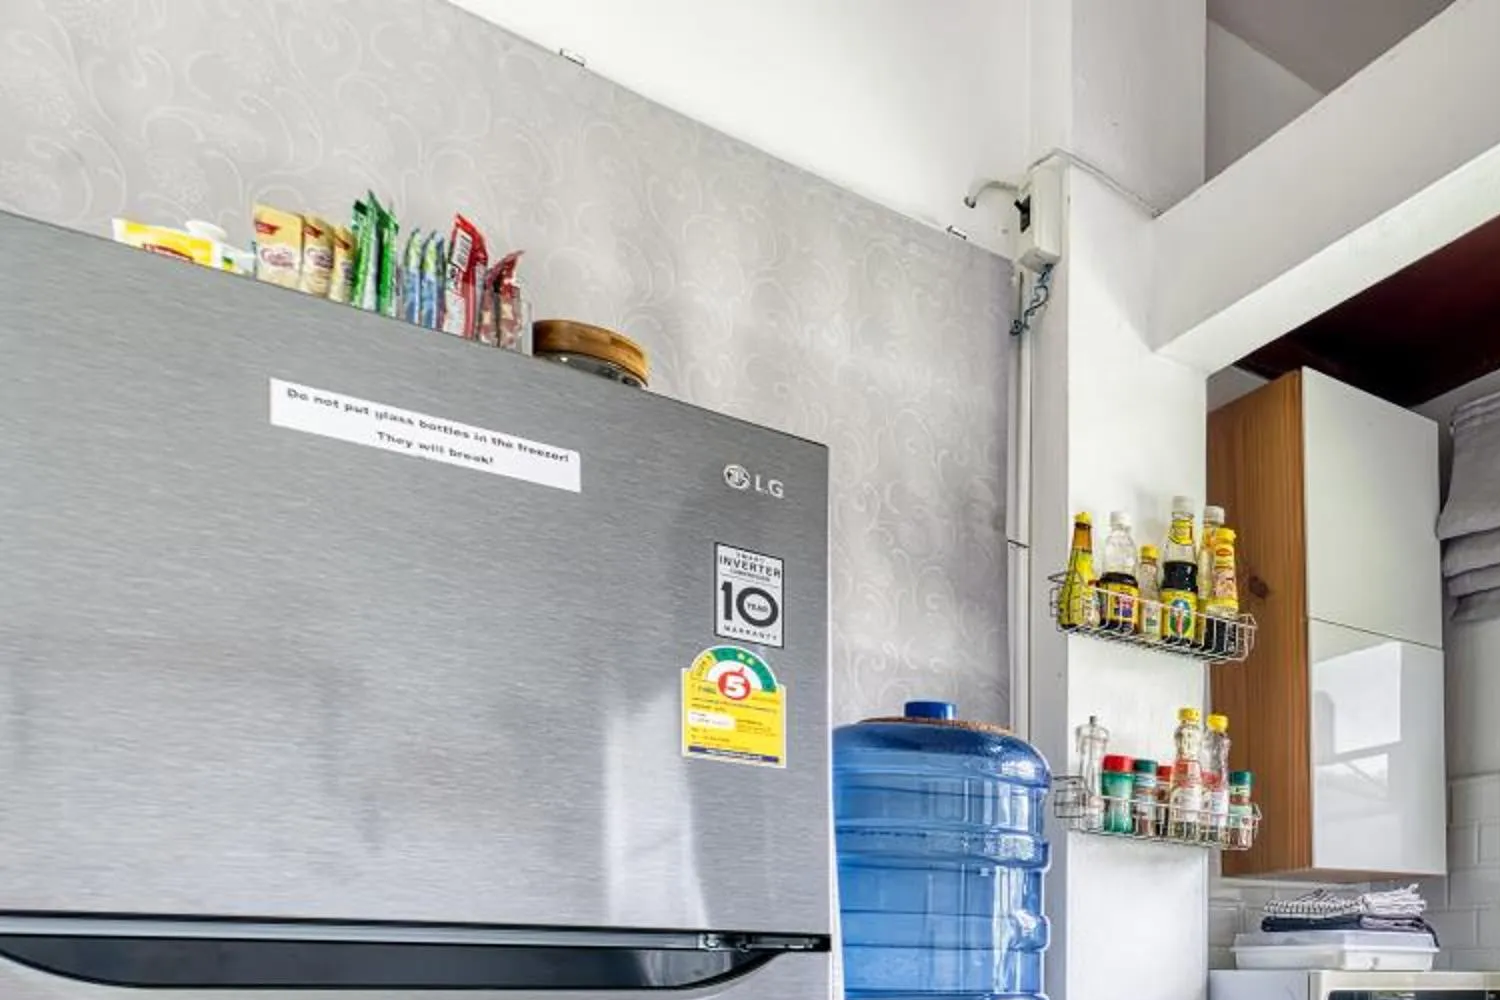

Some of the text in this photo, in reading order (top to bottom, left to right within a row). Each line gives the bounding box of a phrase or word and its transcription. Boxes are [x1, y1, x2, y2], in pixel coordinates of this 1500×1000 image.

[287, 387, 570, 463] Do not put glass bottles in the freezer!
[376, 430, 494, 466] They will break!
[754, 474, 785, 500] LG
[719, 555, 781, 579] INVERTER
[720, 581, 779, 628] 10
